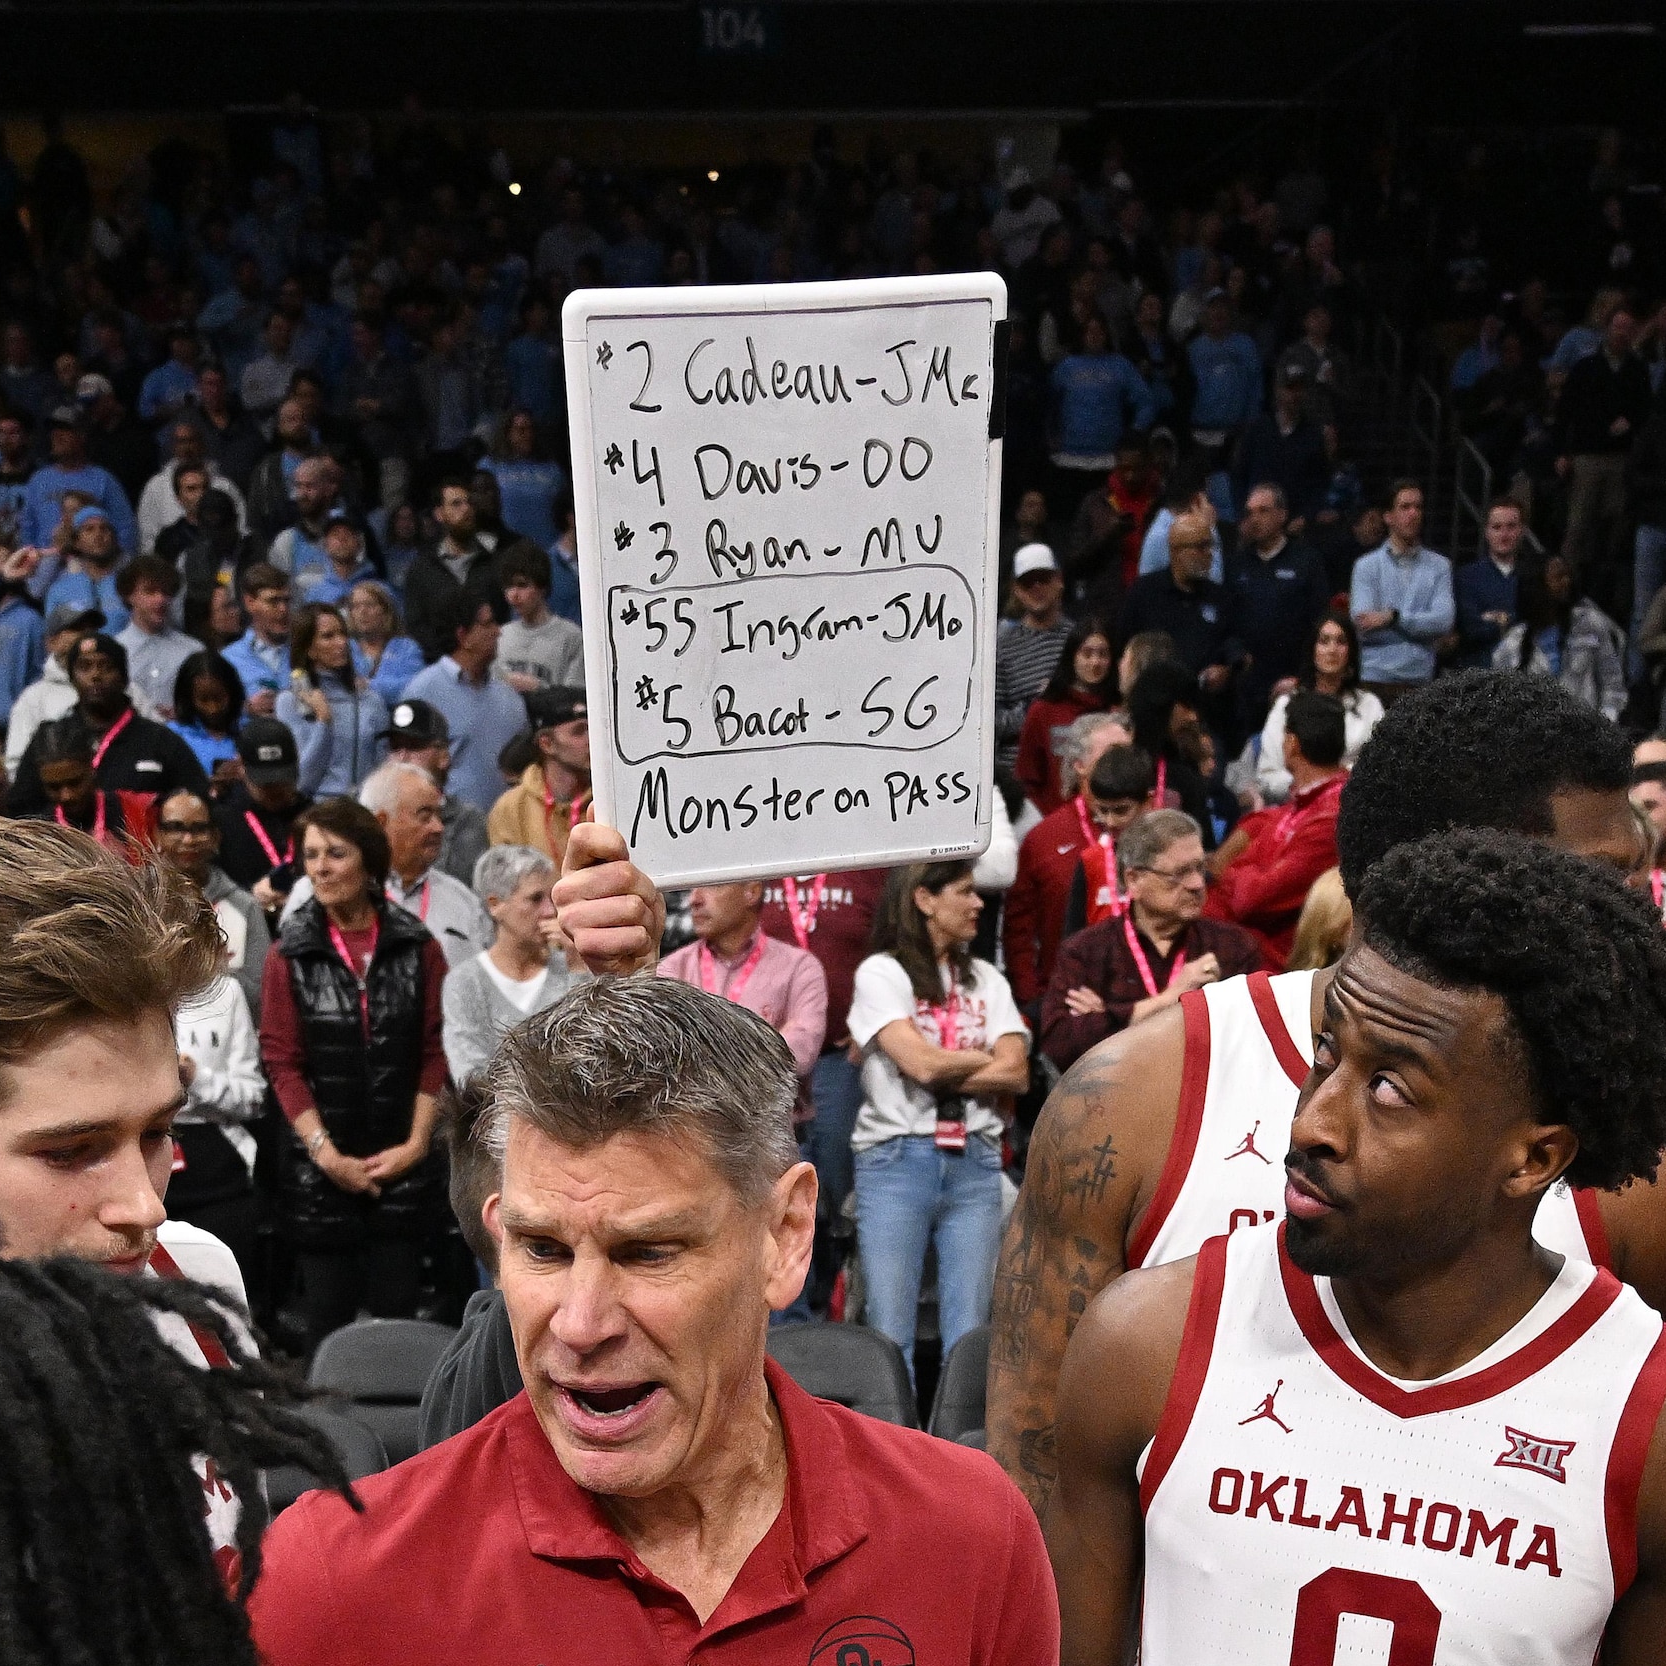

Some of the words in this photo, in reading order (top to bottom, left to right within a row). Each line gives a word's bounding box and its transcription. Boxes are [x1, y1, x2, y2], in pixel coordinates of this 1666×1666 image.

[596, 340, 661, 412] #2
[604, 439, 666, 506] #4
[614, 521, 679, 584] #3
[706, 518, 811, 579] Ryan
[620, 597, 697, 657] #55
[635, 675, 692, 749] #5
[714, 684, 810, 746] Bacot
[631, 767, 828, 848] Monster
[836, 787, 870, 812] on
[884, 771, 972, 821] PASS
[1208, 1467, 1562, 1578] OKLAHOMA
